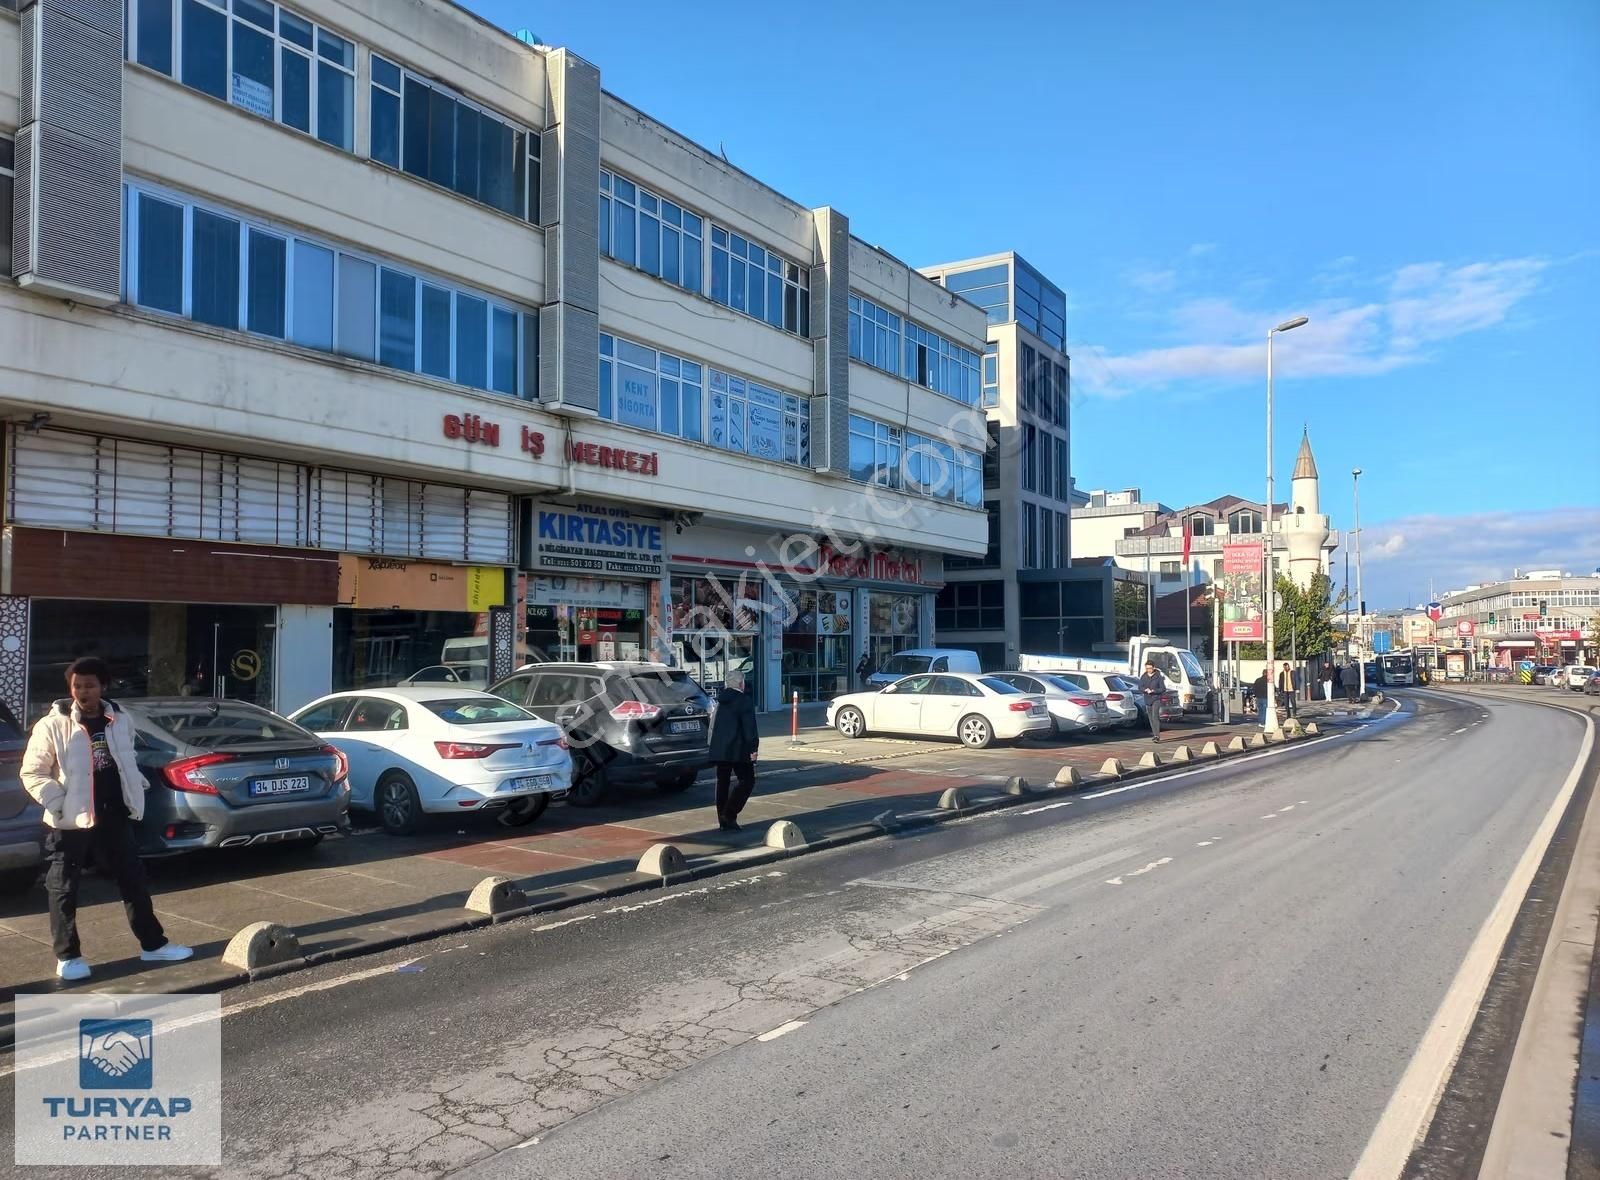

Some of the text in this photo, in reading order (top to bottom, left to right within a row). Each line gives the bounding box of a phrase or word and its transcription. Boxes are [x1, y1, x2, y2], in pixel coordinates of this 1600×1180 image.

[624, 379, 648, 397] KENT
[443, 413, 658, 476] GÜN İŞ MERKEZİ
[576, 503, 607, 515] ATLAS
[256, 777, 307, 793] 34 DJS 223
